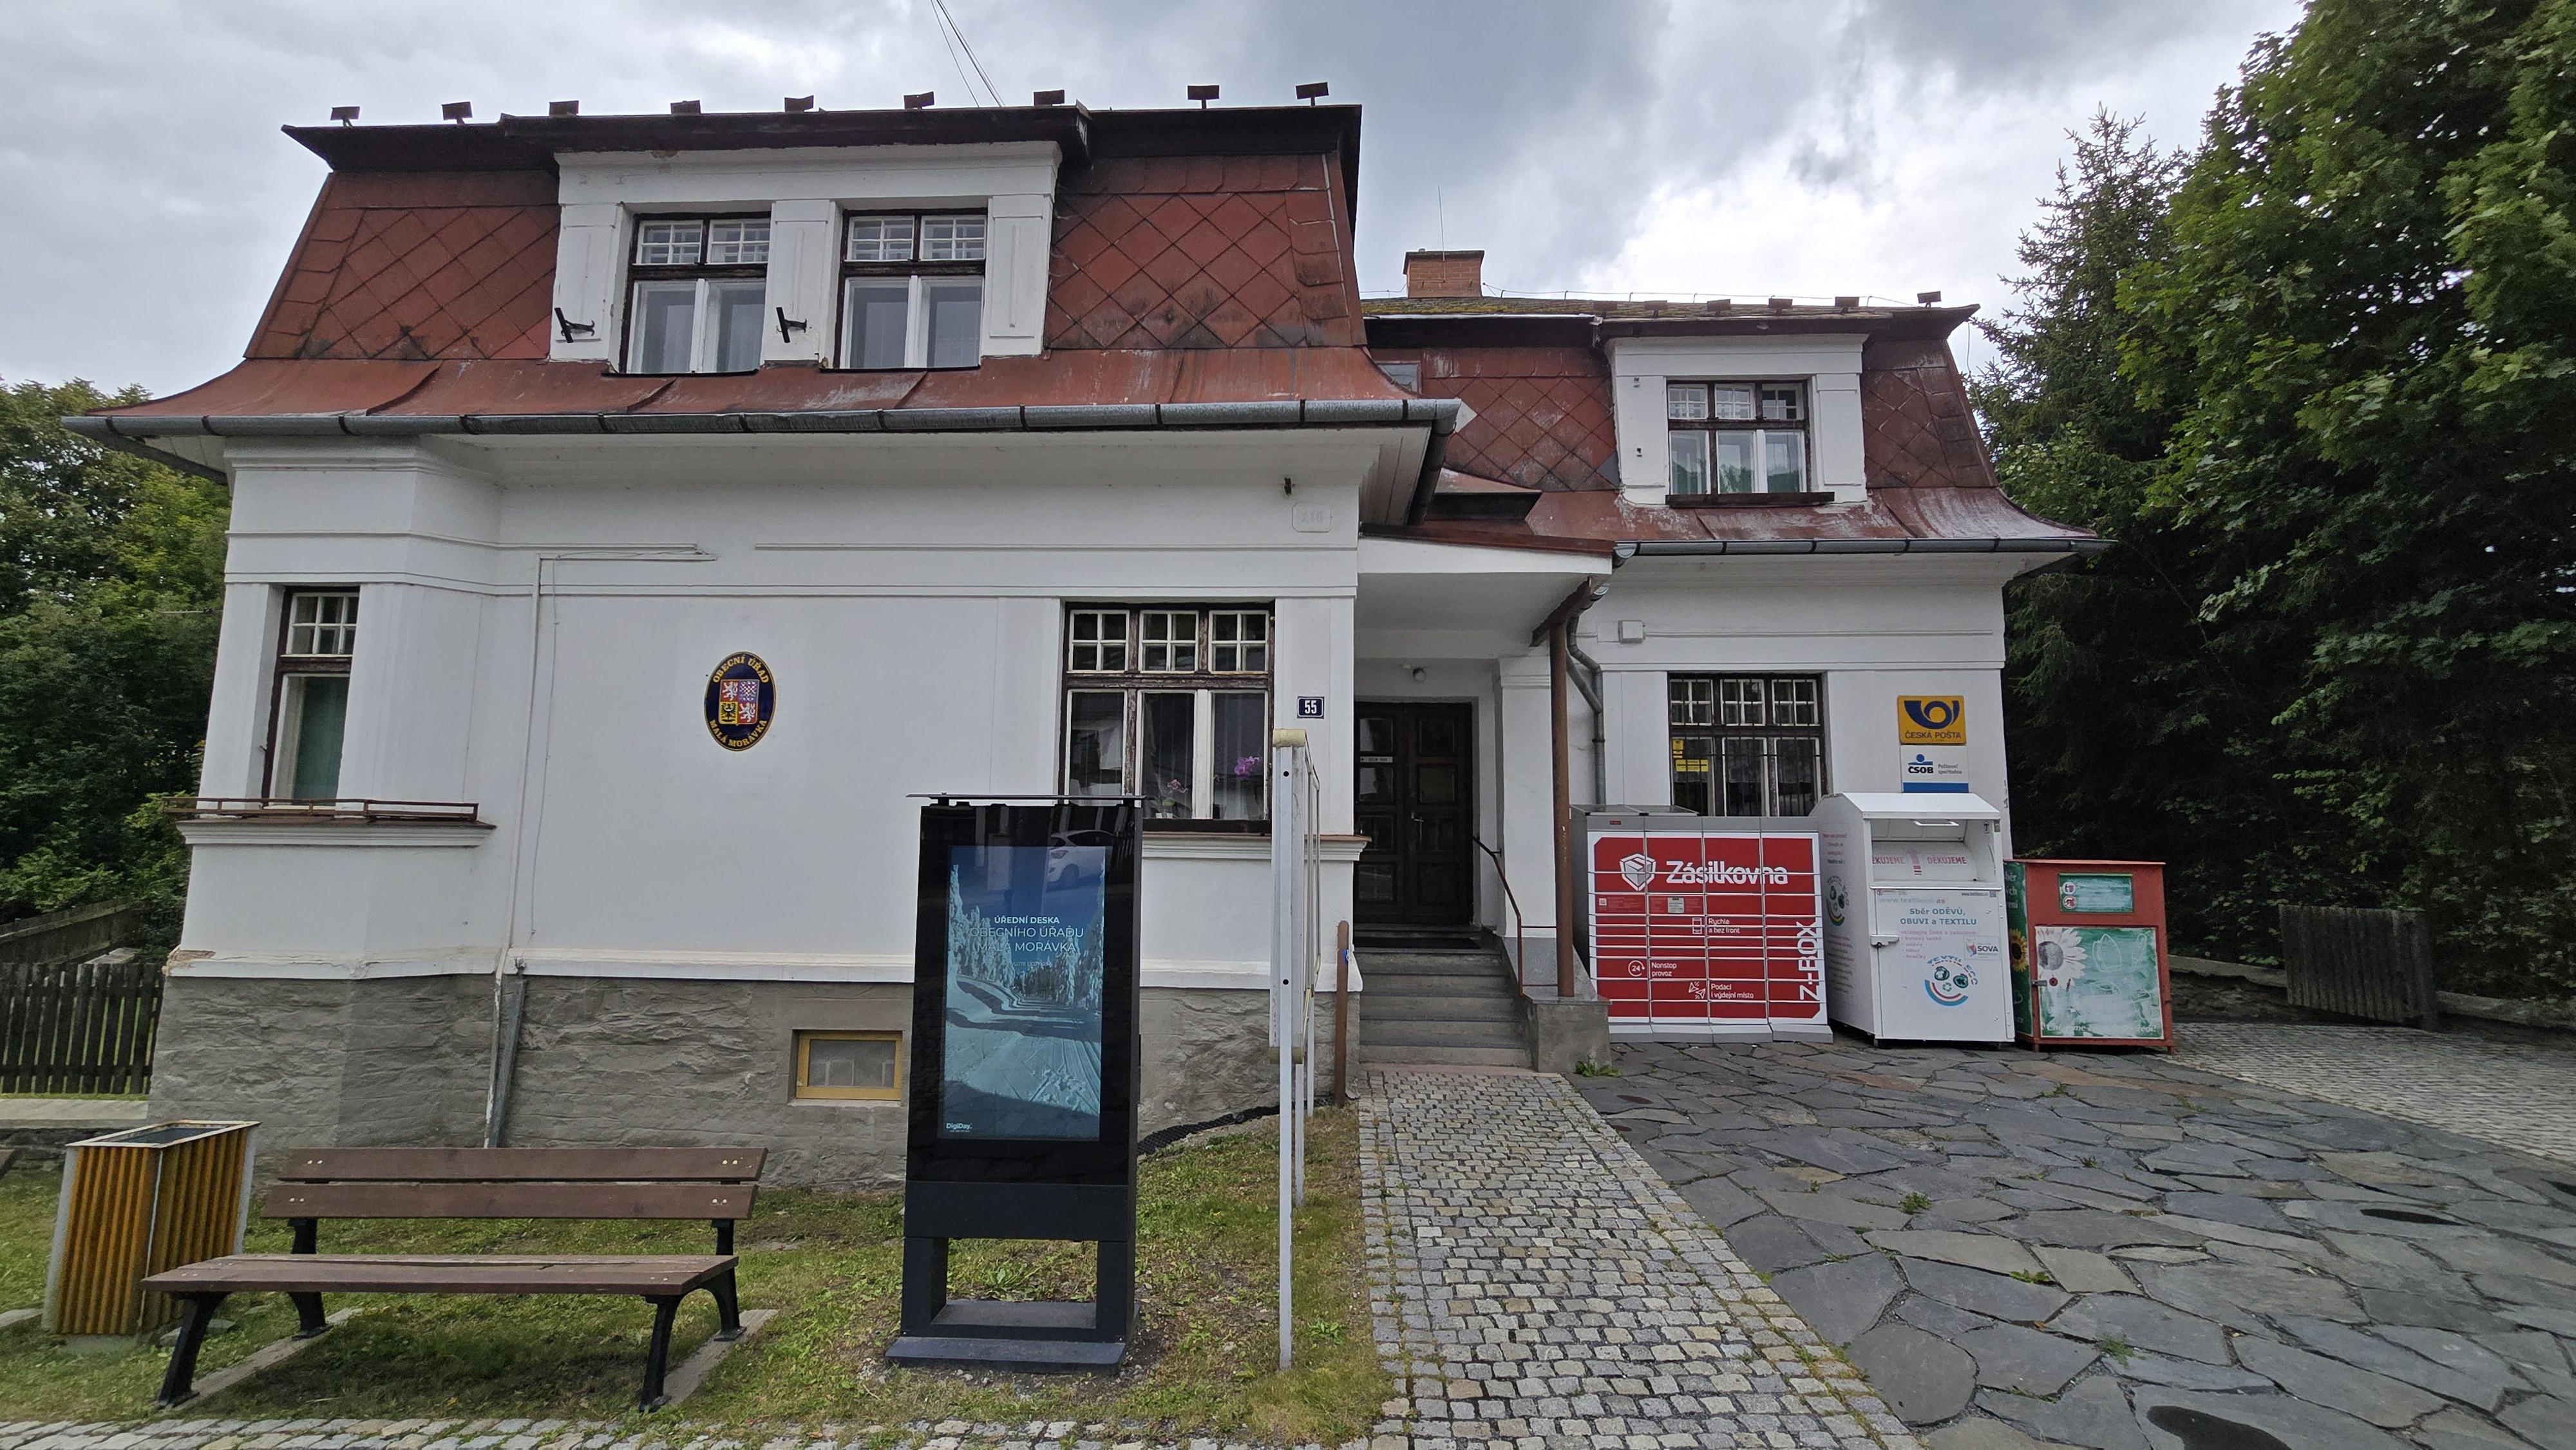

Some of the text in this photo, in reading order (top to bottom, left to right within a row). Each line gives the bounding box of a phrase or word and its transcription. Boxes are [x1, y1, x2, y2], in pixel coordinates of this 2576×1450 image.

[713, 655, 769, 683] OBECNÍ ÚŘAD
[1305, 700, 1317, 714] 55
[710, 719, 767, 746] MALÁ MORÁVKA
[1905, 730, 1932, 739] ČESKÁ
[1666, 861, 1788, 885] Zásilkovna
[1932, 907, 1965, 916] ODĚVŮ,
[994, 915, 1028, 923] ÚŘEDNÍ
[970, 925, 1083, 937] OBECNÍHO ÚŘADU
[1015, 940, 1075, 951] MORÁVKA
[1796, 922, 1820, 1001] Z-BOX
